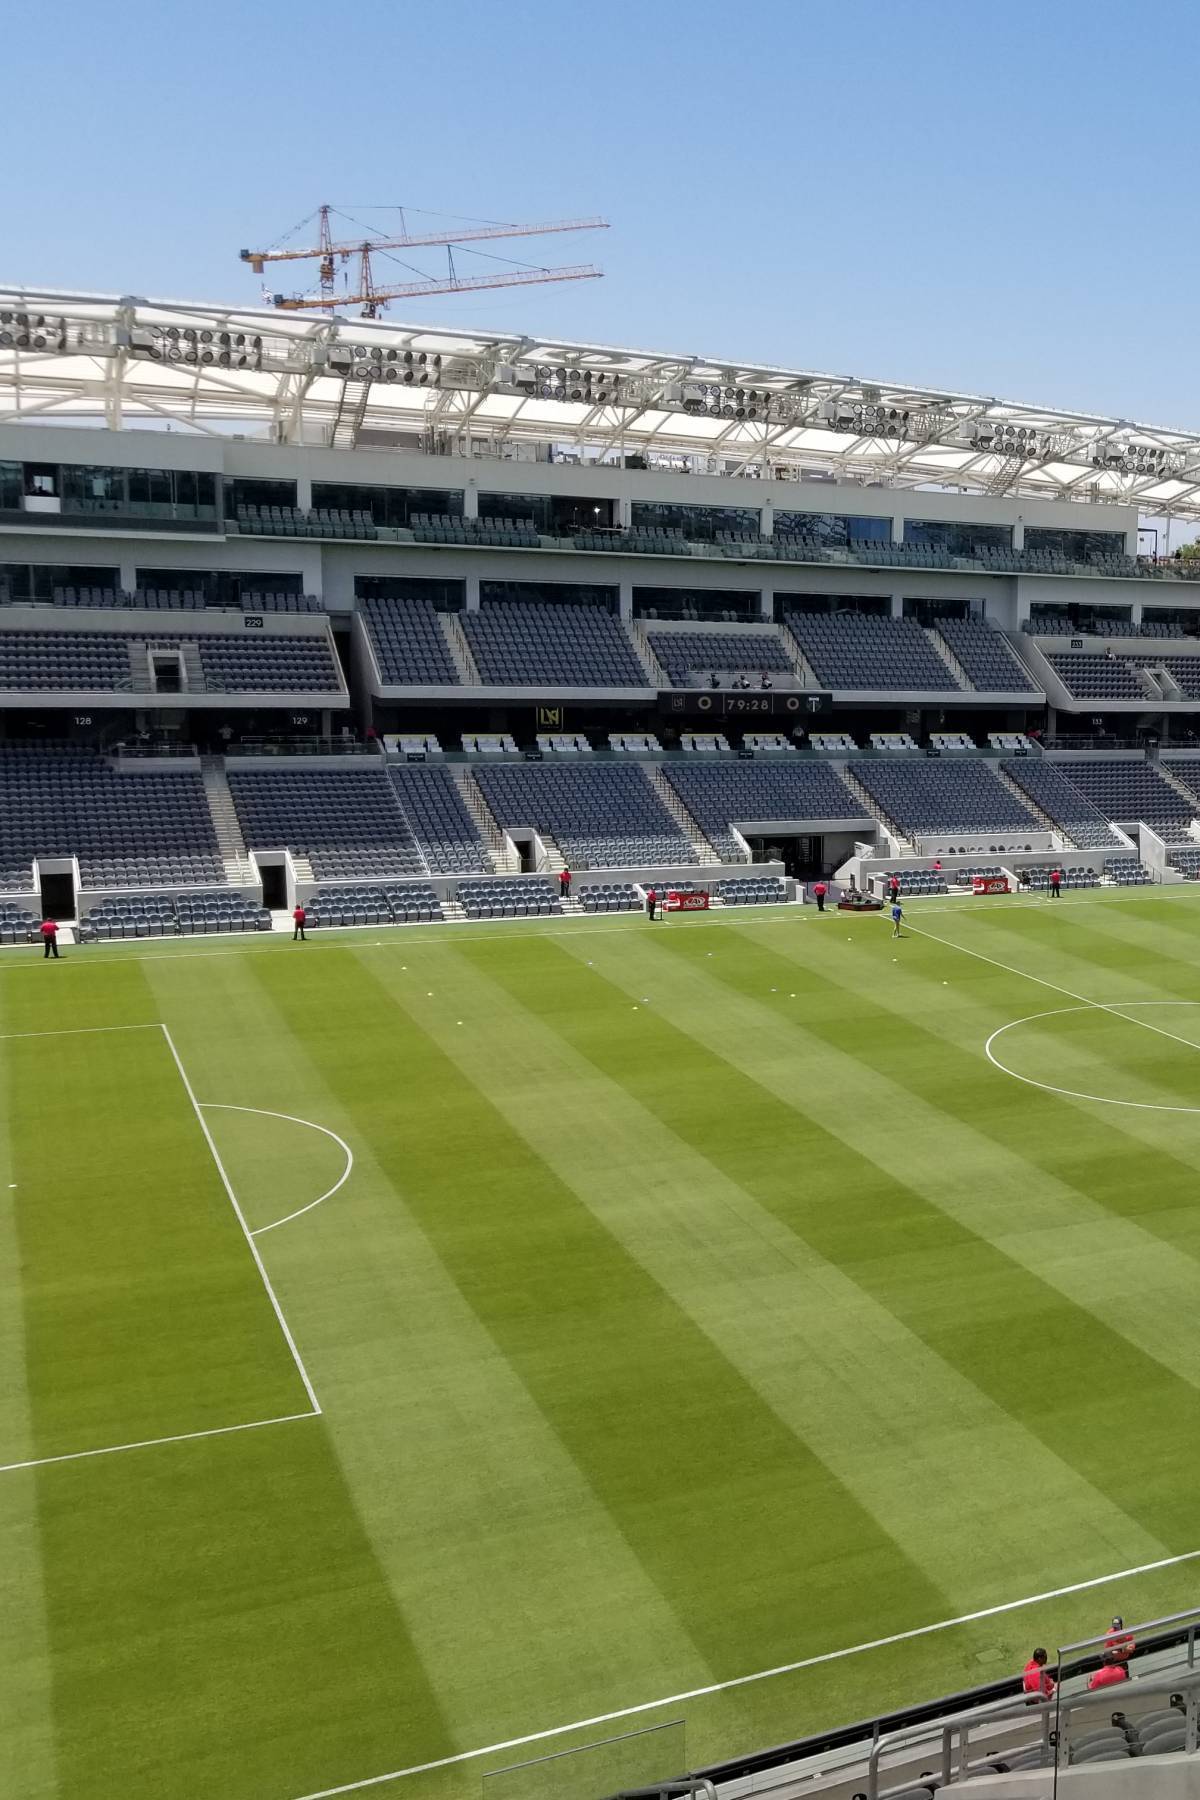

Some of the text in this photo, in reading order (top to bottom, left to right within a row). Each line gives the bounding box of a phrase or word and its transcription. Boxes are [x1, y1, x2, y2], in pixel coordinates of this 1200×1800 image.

[246, 617, 262, 627] 229
[728, 700, 769, 710] 79:28
[75, 717, 92, 725] 128
[293, 717, 308, 725] 129
